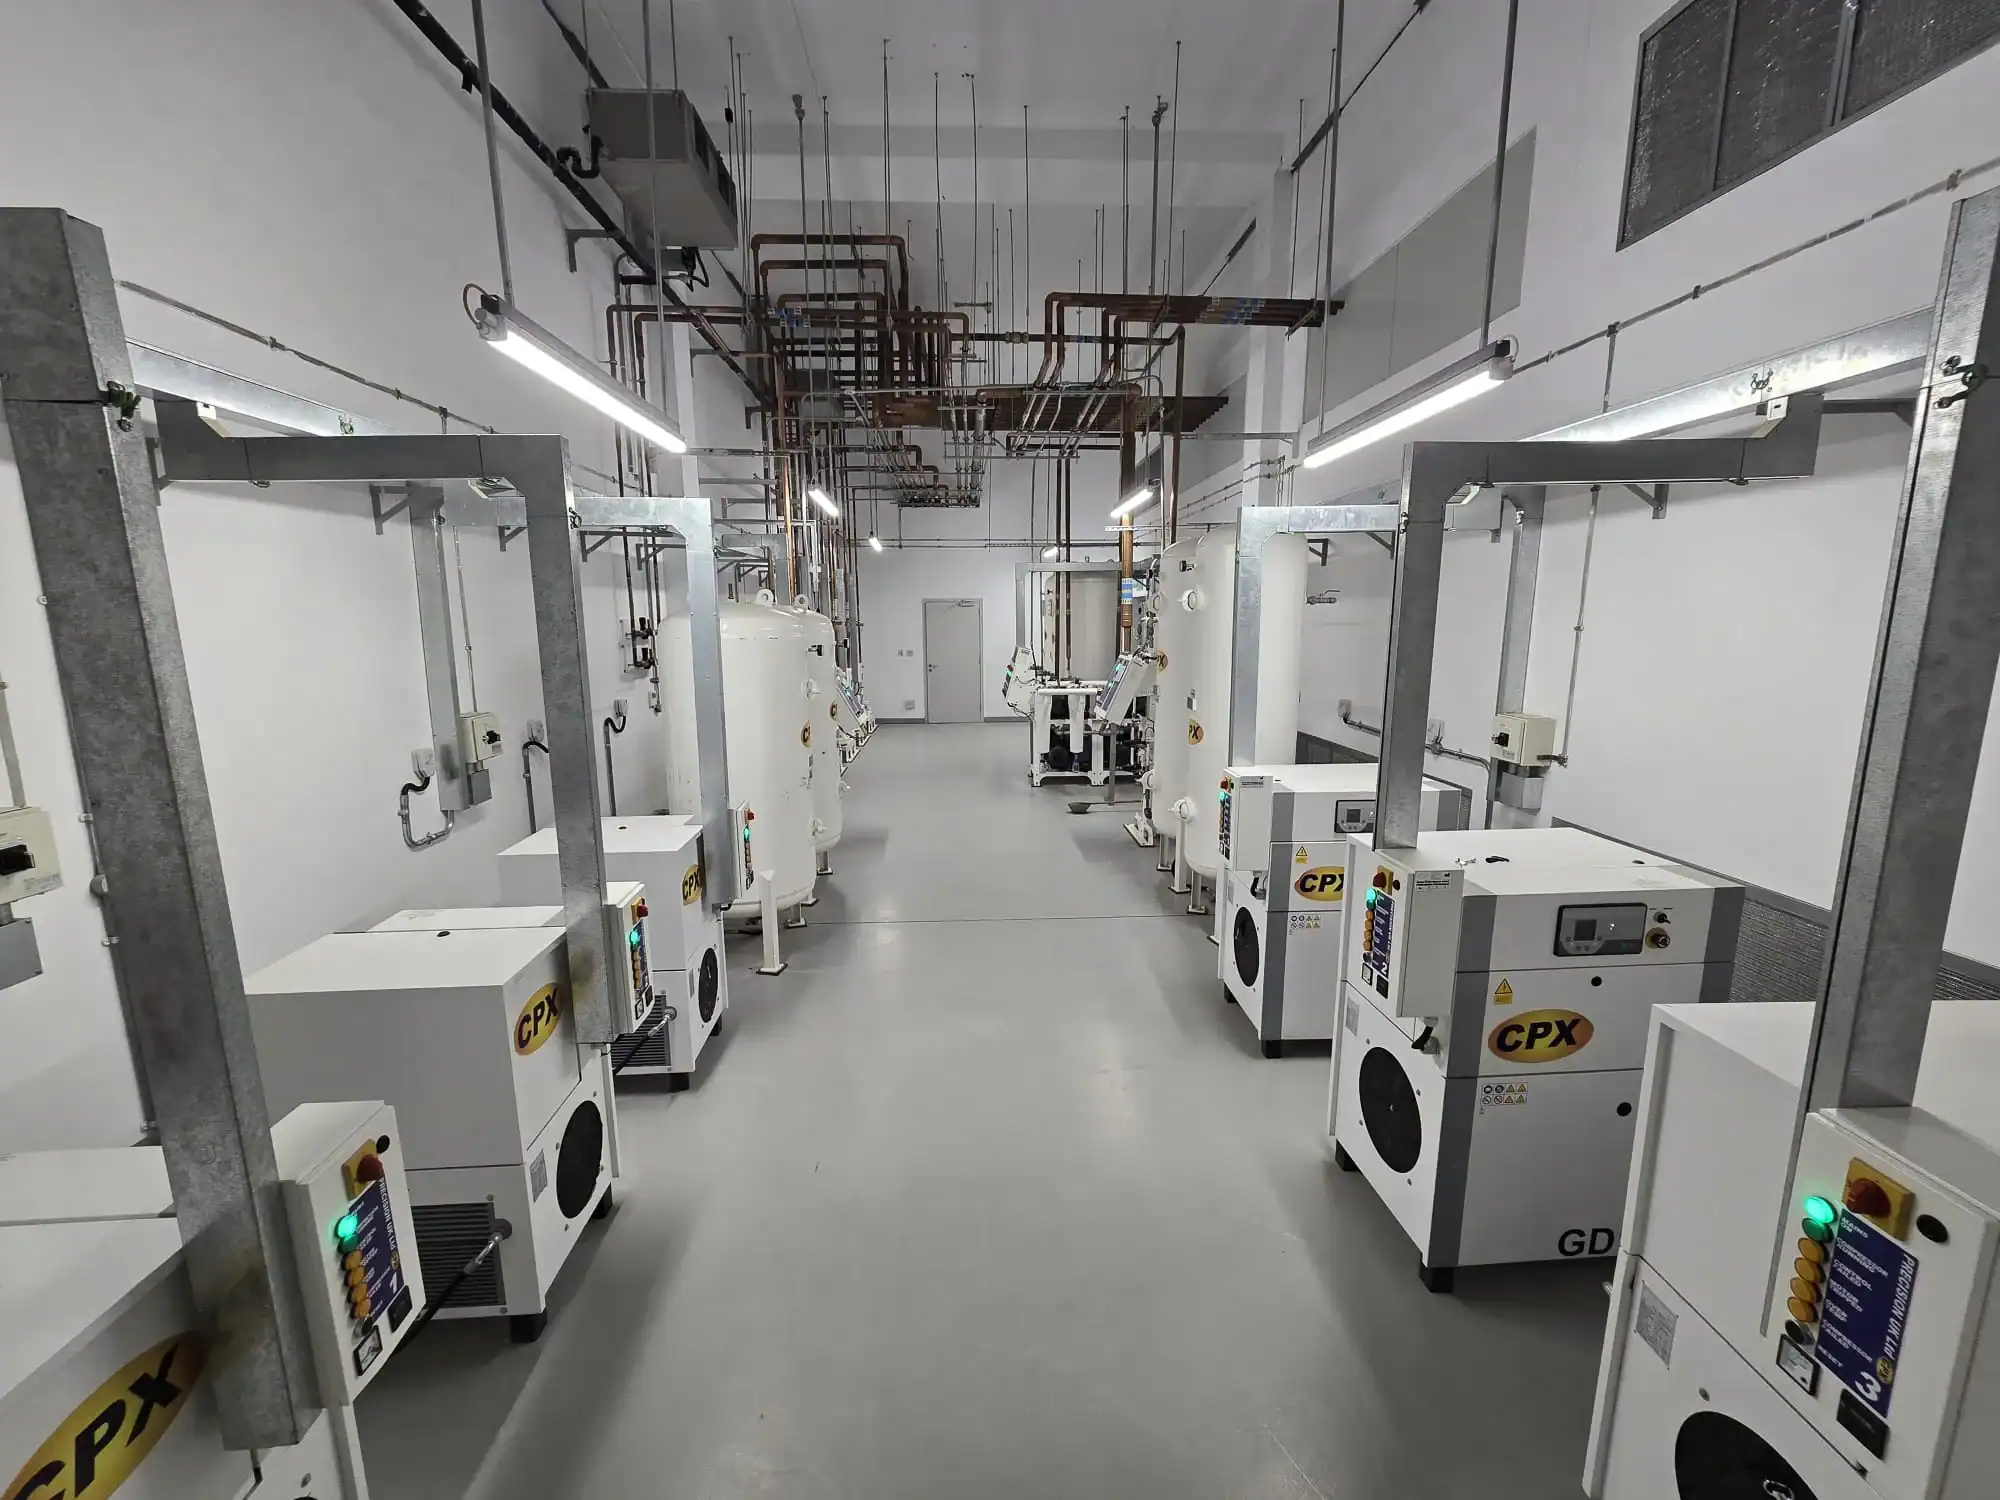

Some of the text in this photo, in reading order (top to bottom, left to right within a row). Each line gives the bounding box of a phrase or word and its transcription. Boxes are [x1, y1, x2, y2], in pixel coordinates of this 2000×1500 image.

[682, 868, 700, 900] CPX
[1381, 962, 1388, 975] 2
[517, 987, 558, 1049] CPX
[1496, 1018, 1582, 1053] CPX
[1840, 1222, 1853, 1233] ON
[1841, 1217, 1869, 1239] MAINS
[1836, 1237, 1889, 1277] COMPRESSOR
[1836, 1242, 1876, 1274] RUNNING
[389, 1271, 398, 1295] 1
[1832, 1263, 1861, 1288] FAILED
[1833, 1259, 1873, 1292] CONTROL
[1828, 1284, 1863, 1313] TRIPPED
[1829, 1279, 1860, 1304] MOTOR
[1883, 1253, 1916, 1361] PRECISION UK Ltd
[1820, 1323, 1850, 1350] FAILED
[1822, 1319, 1873, 1362] COMPRESSOR
[1817, 1344, 1844, 1368] RESET
[1855, 1371, 1882, 1402] 3
